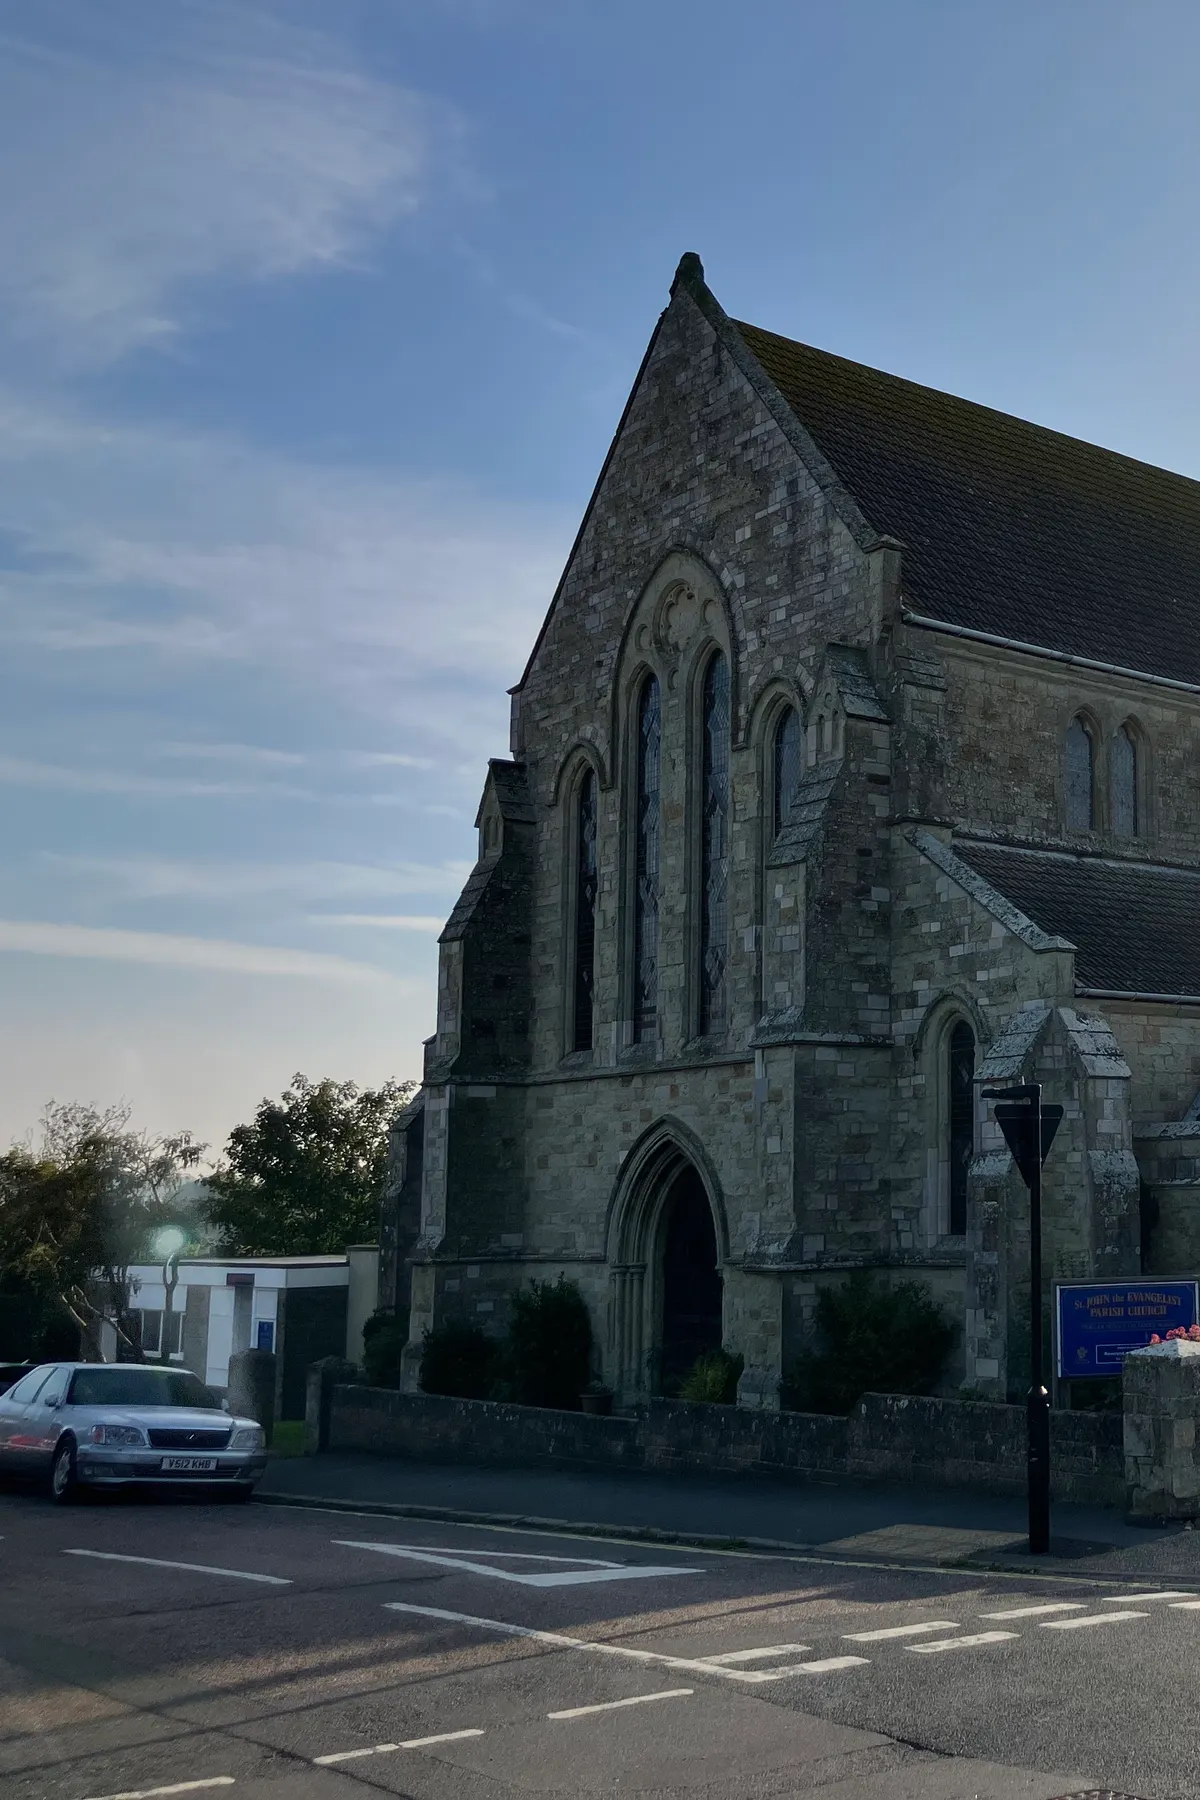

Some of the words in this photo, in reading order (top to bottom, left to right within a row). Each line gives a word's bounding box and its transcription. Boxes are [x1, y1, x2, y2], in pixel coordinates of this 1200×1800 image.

[1087, 1294, 1110, 1309] JOHN
[1112, 1294, 1124, 1302] the
[1127, 1292, 1182, 1306] EVANGELIST
[1090, 1307, 1124, 1317] PARISH
[1128, 1305, 1167, 1316] CHURCH
